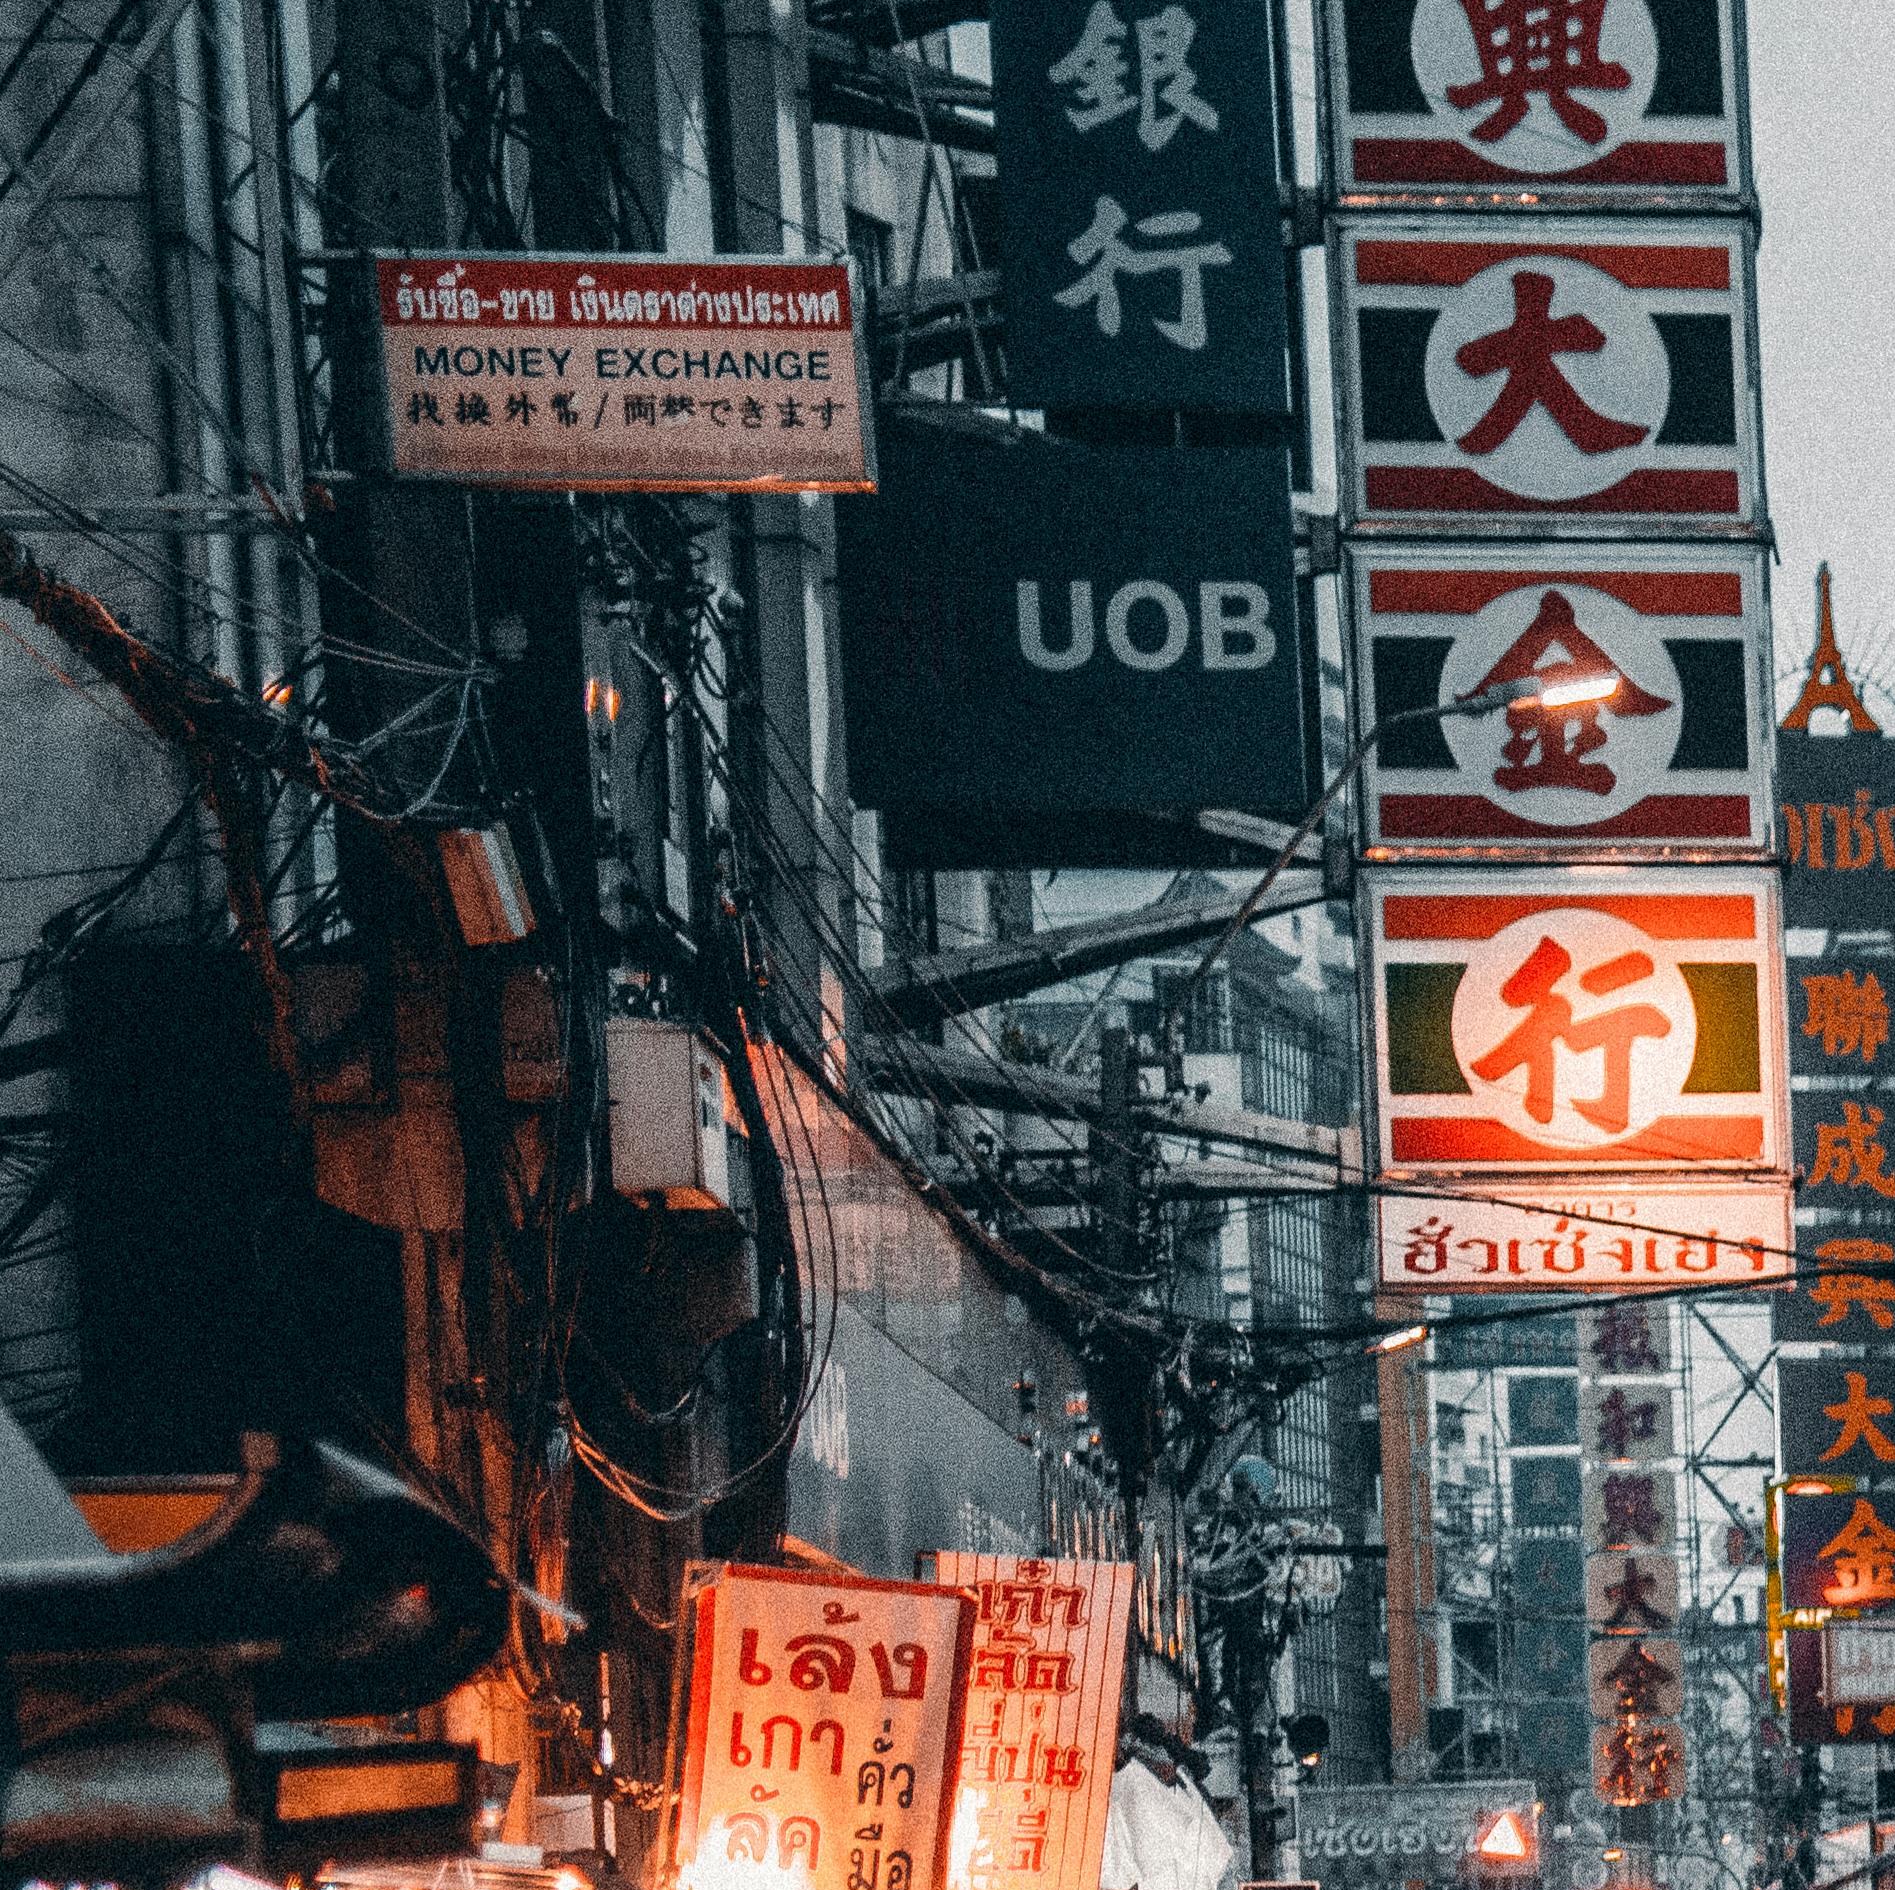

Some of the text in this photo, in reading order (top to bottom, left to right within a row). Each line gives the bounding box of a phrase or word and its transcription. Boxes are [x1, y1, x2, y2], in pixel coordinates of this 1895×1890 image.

[1049, 0, 1233, 350] 銀行
[570, 274, 840, 324] เงินตราต่างประเทศ
[414, 346, 831, 381] MONEY EXCHANGE
[1017, 581, 1277, 671] UOB
[729, 1711, 845, 1776] เกา
